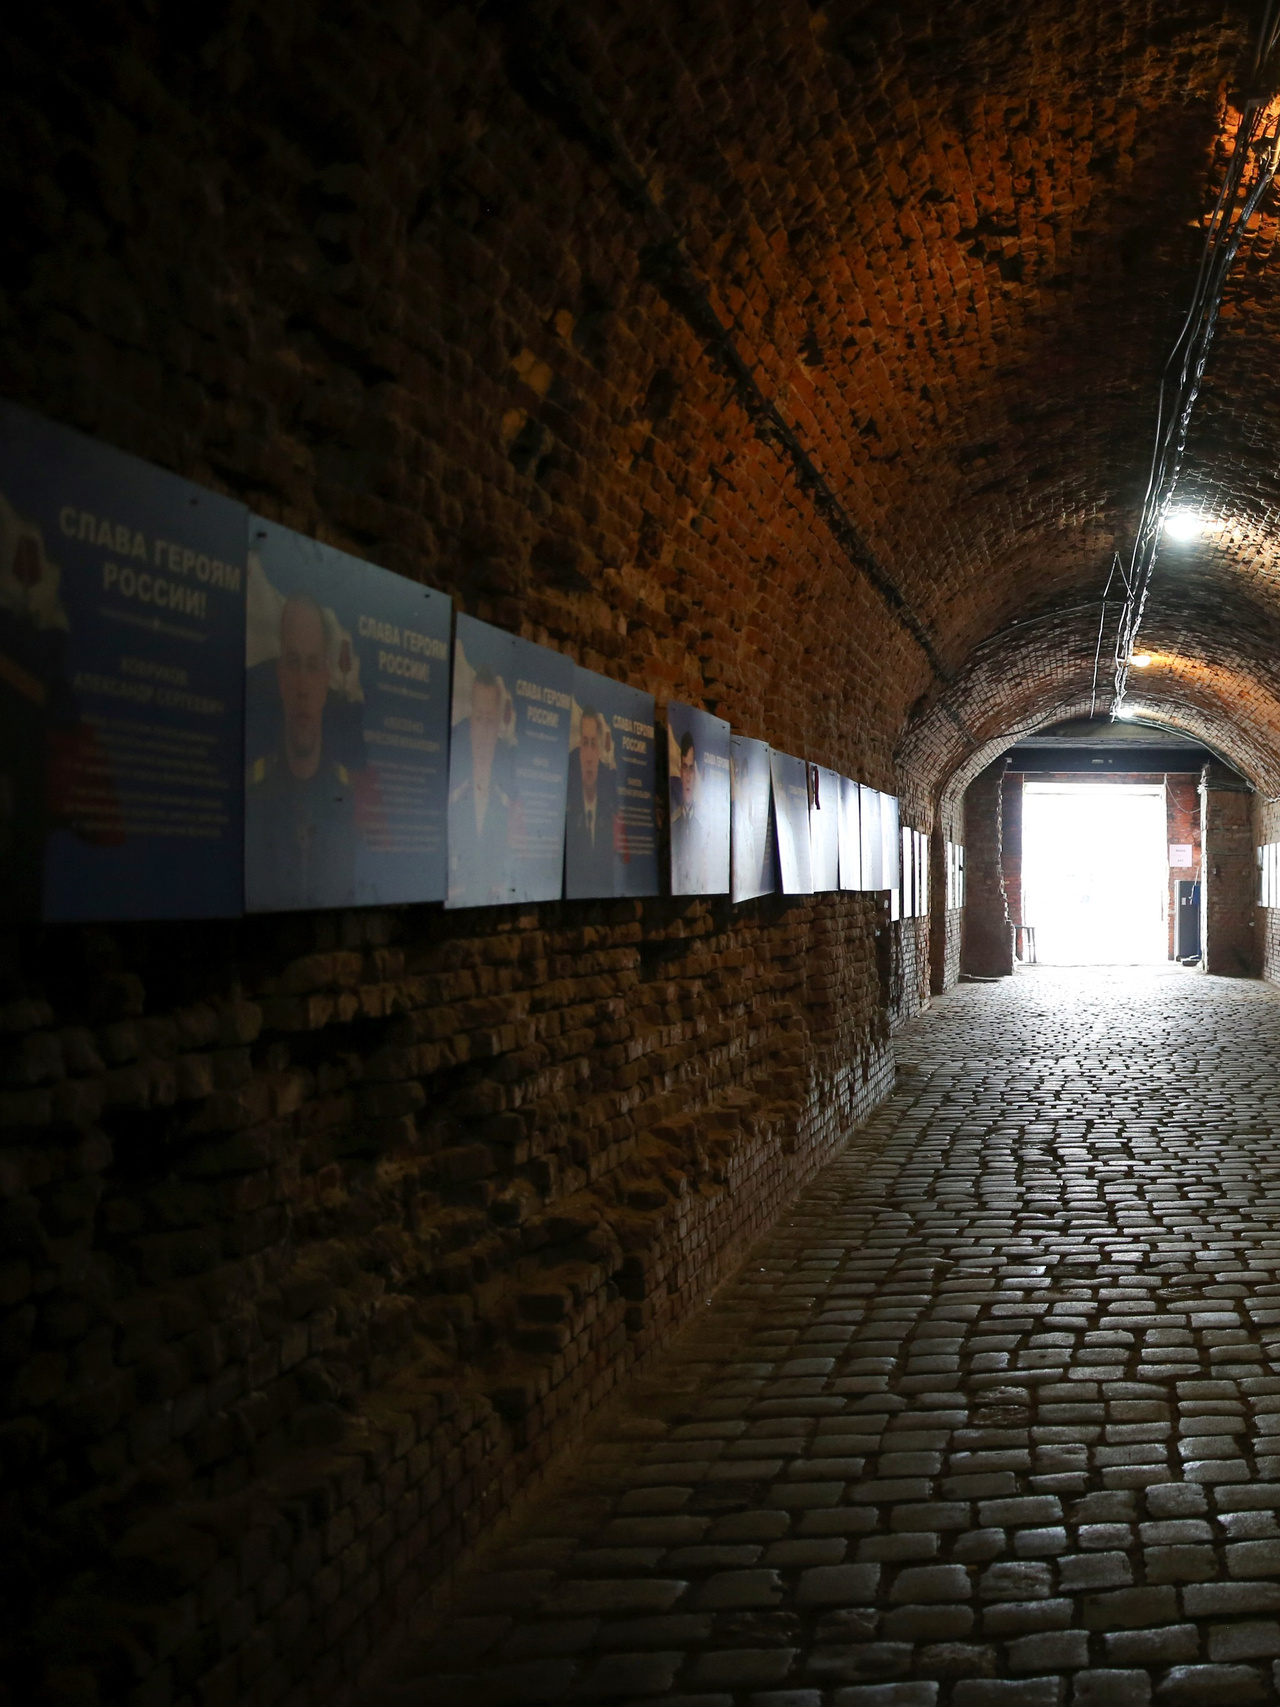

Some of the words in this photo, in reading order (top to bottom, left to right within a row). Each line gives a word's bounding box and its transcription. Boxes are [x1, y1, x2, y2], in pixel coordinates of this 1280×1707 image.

[59, 505, 147, 561] СЛАВА
[153, 538, 241, 593] ГЕРОЯМ
[103, 561, 207, 620] РОССИИ!
[359, 614, 401, 647] СЛАВА
[403, 629, 448, 662] ГЕРОЯМ
